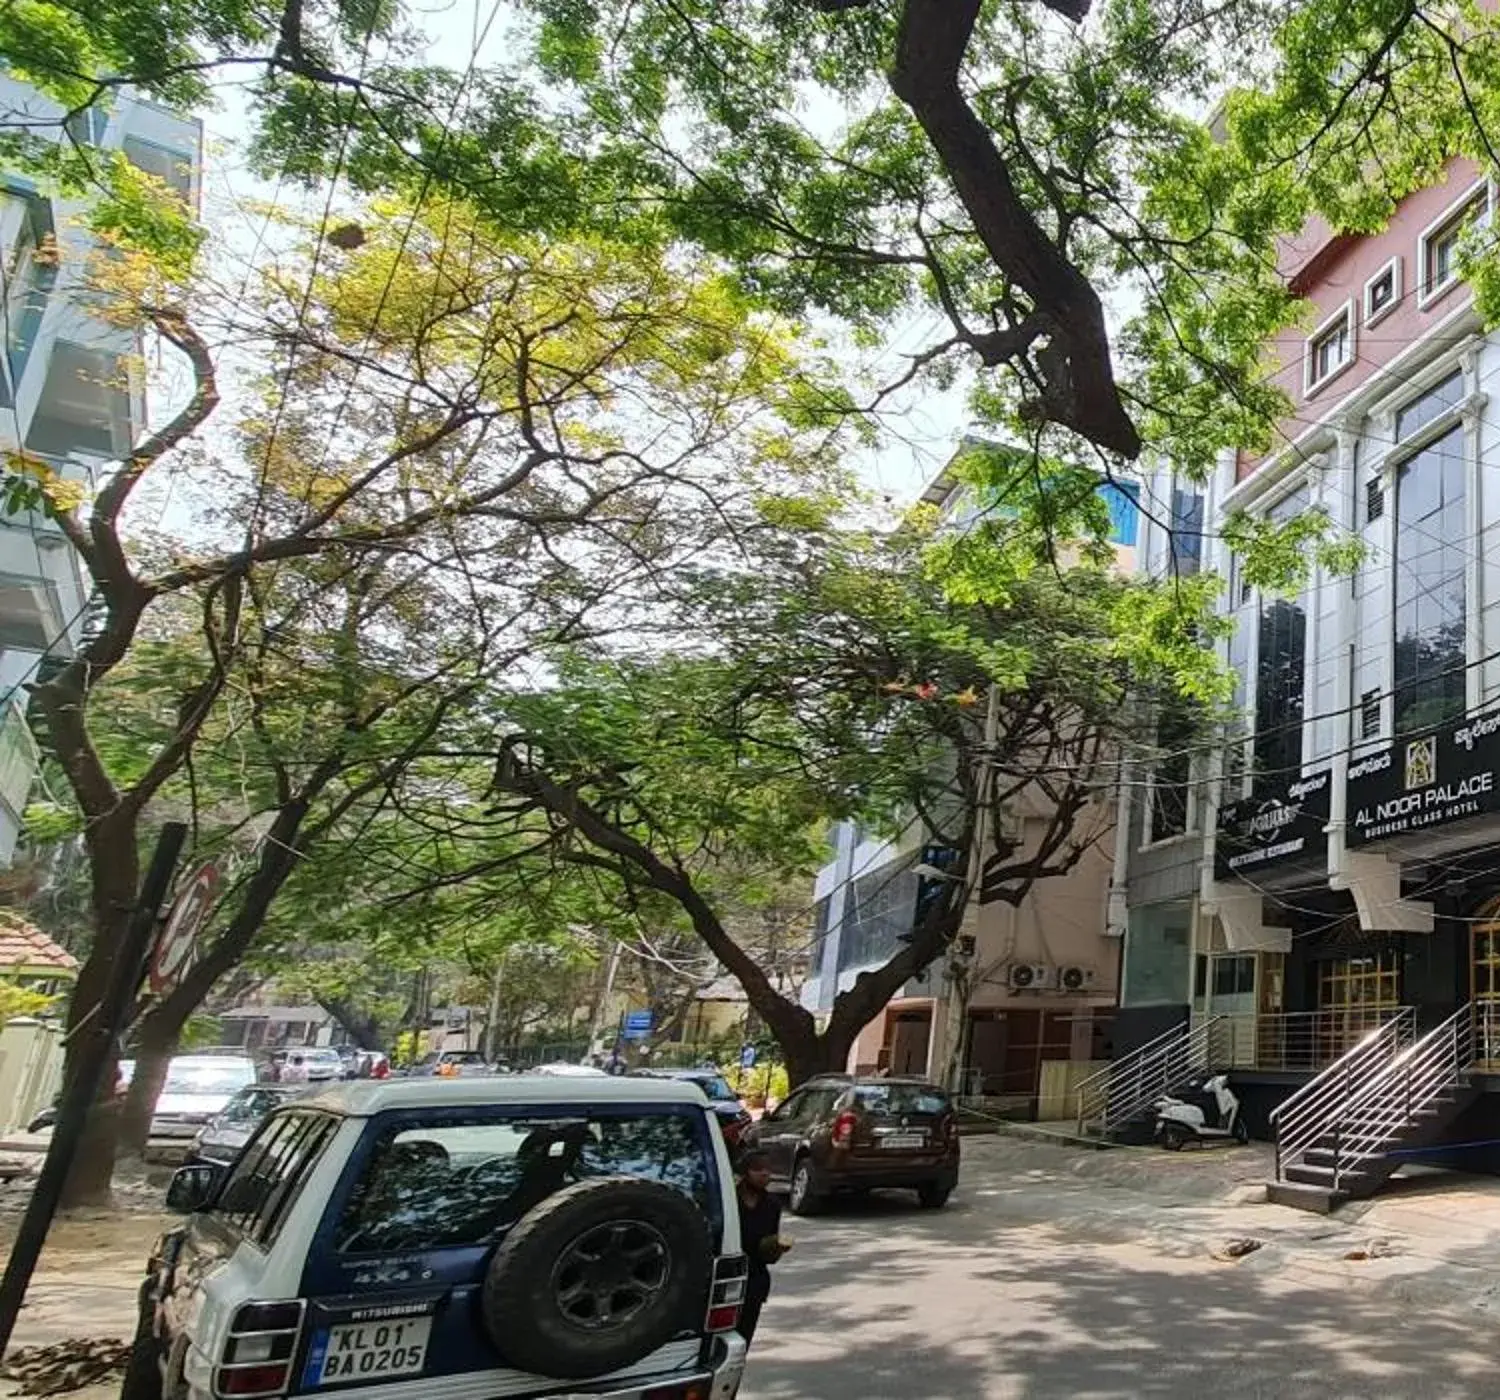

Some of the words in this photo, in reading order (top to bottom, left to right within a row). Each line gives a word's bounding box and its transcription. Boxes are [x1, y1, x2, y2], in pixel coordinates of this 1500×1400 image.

[1355, 808, 1374, 827] AL
[1377, 793, 1422, 820] NOOR
[1425, 772, 1493, 808] PALACE
[1365, 818, 1408, 838] BUSINESS
[1411, 809, 1442, 825] CLASS
[1445, 800, 1479, 817] HOTEL
[352, 1303, 427, 1319] MITSUBISHI
